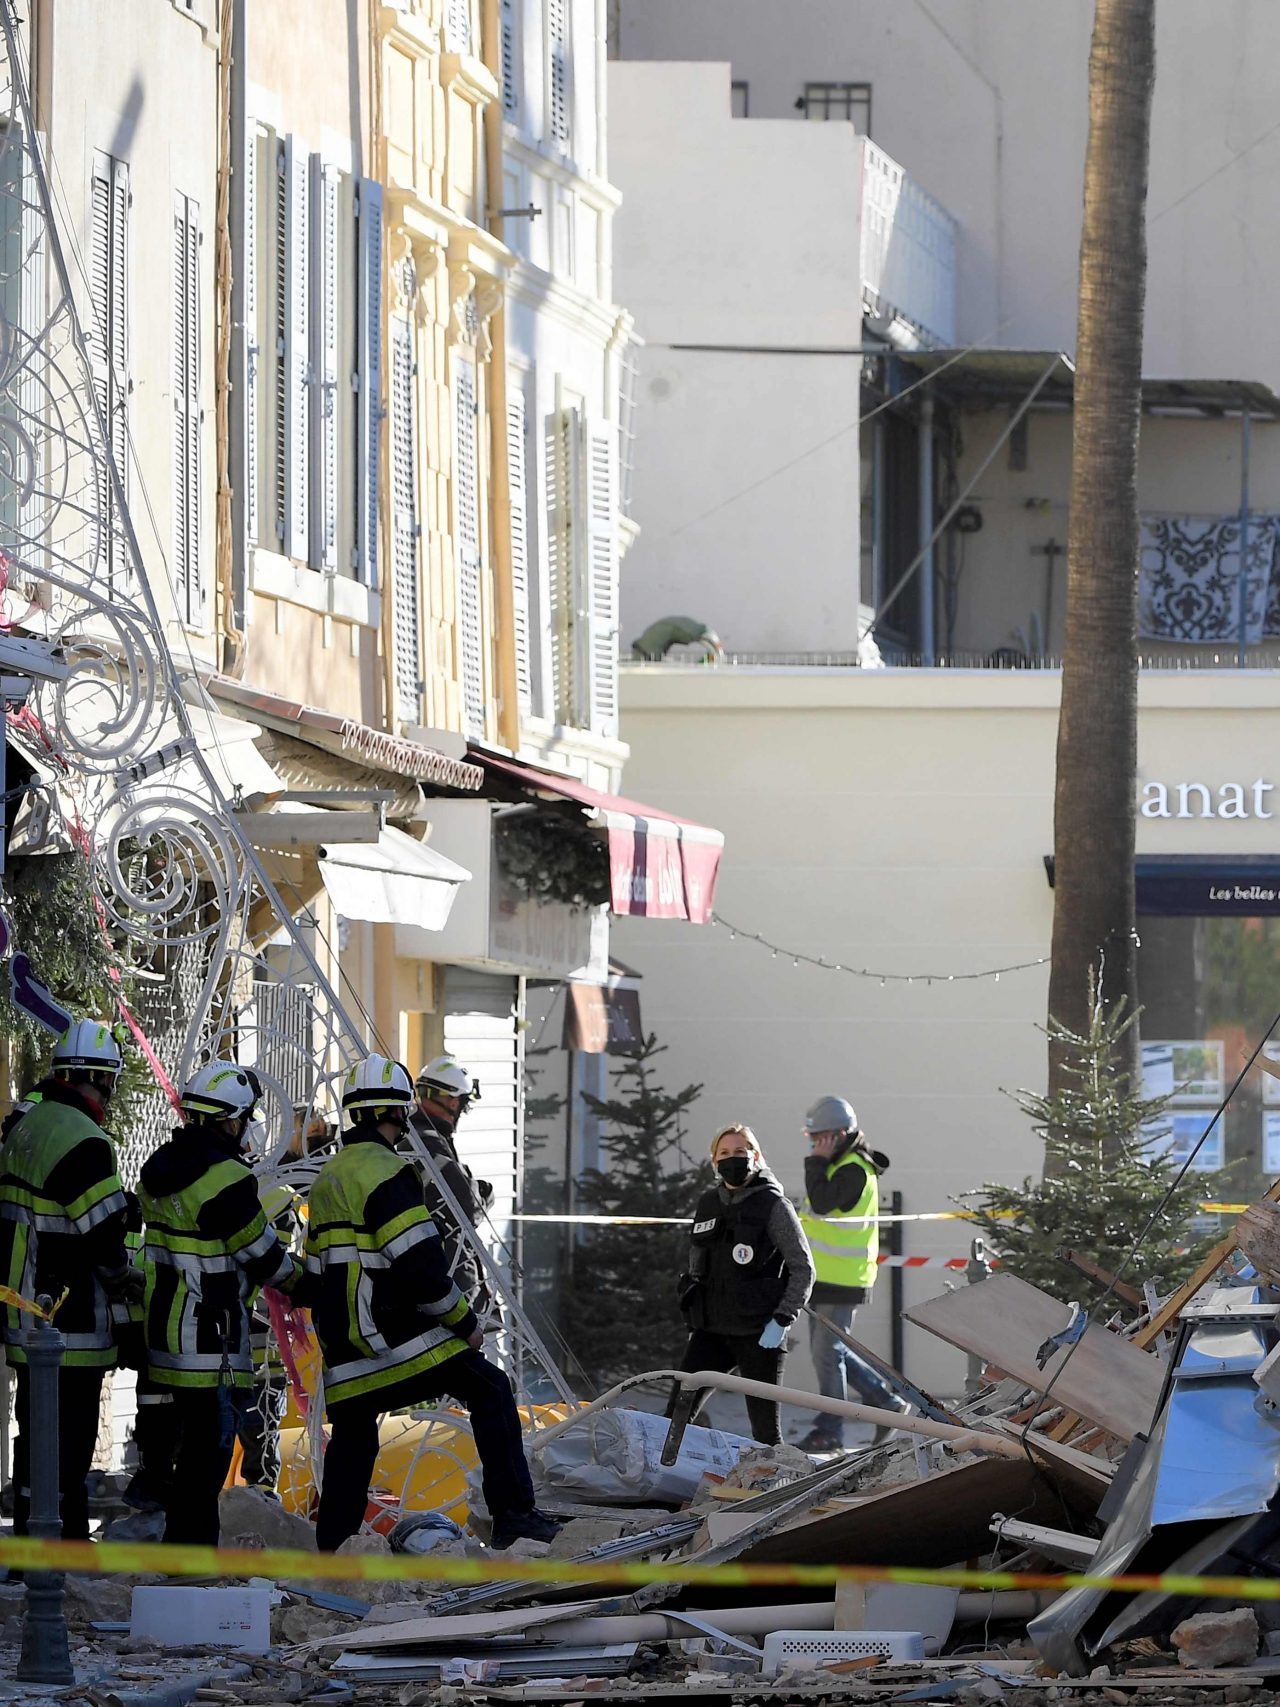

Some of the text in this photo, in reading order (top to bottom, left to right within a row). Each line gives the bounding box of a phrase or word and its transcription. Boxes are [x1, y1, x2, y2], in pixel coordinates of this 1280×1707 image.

[1140, 778, 1275, 819] anat
[1209, 886, 1232, 900] Les
[1234, 885, 1275, 900] belles
[696, 1220, 714, 1232] PTS
